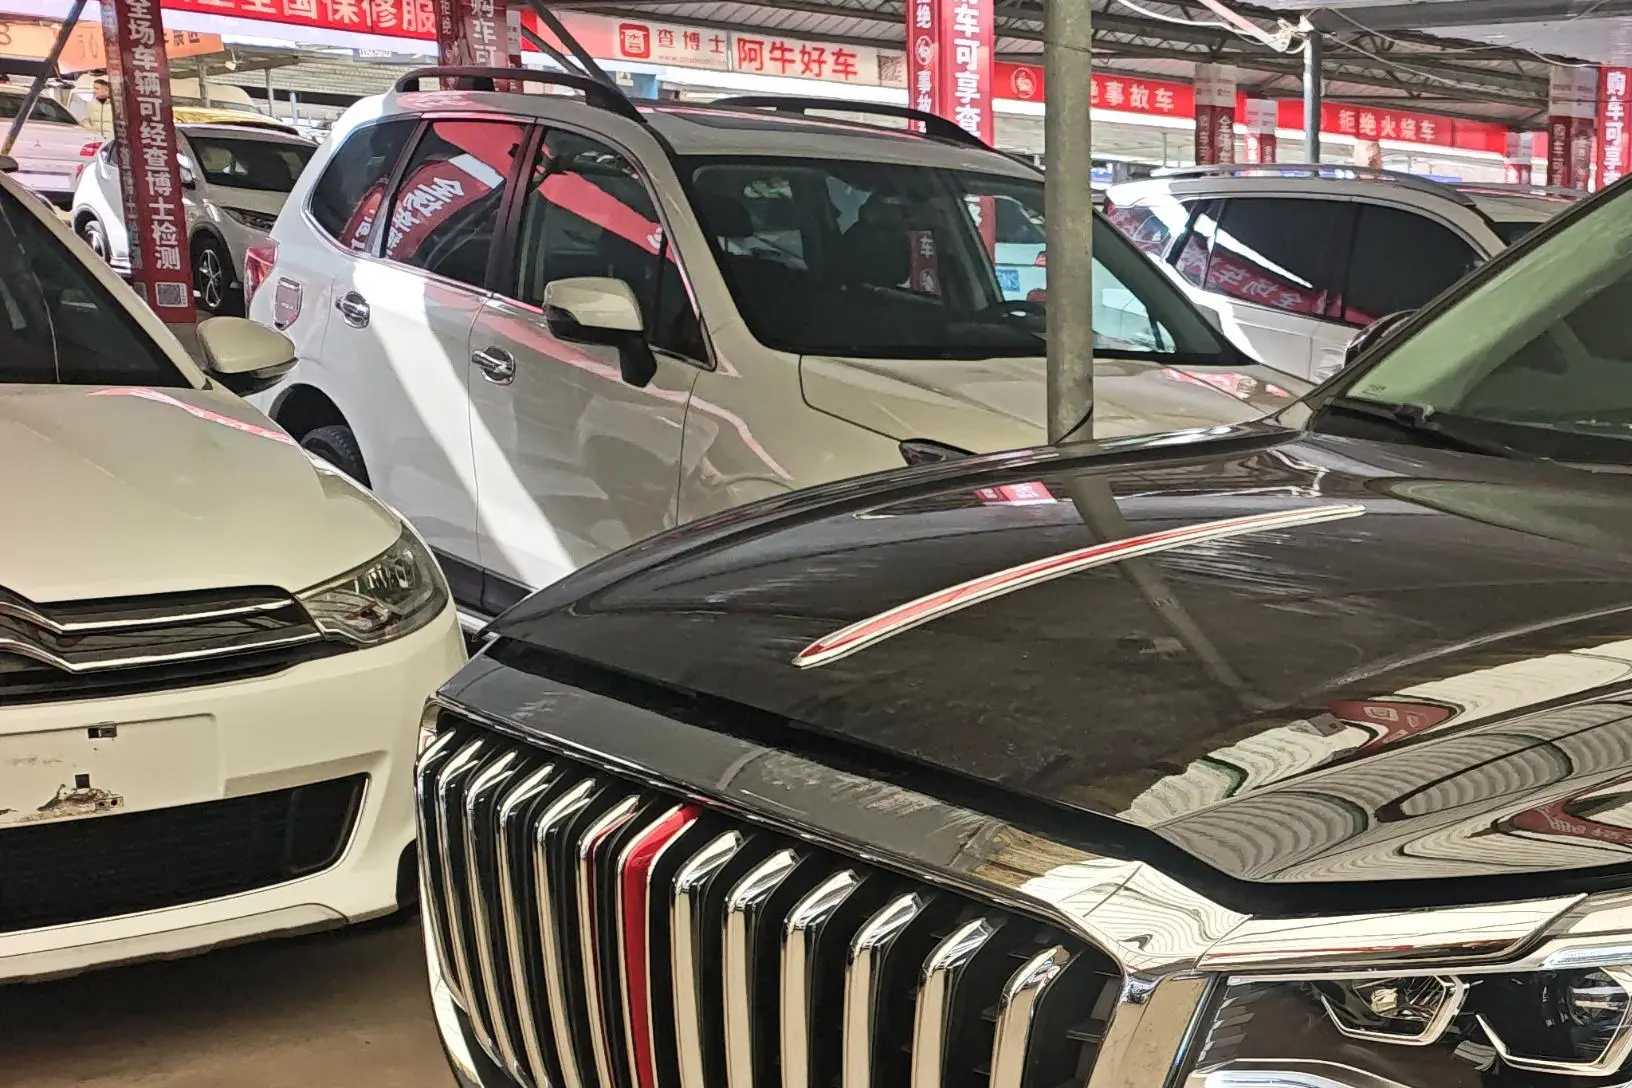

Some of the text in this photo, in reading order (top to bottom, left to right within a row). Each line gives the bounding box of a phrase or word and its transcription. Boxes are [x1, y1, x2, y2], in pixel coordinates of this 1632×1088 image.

[656, 28, 725, 54] 查博士
[736, 37, 858, 80] 阿牛好车
